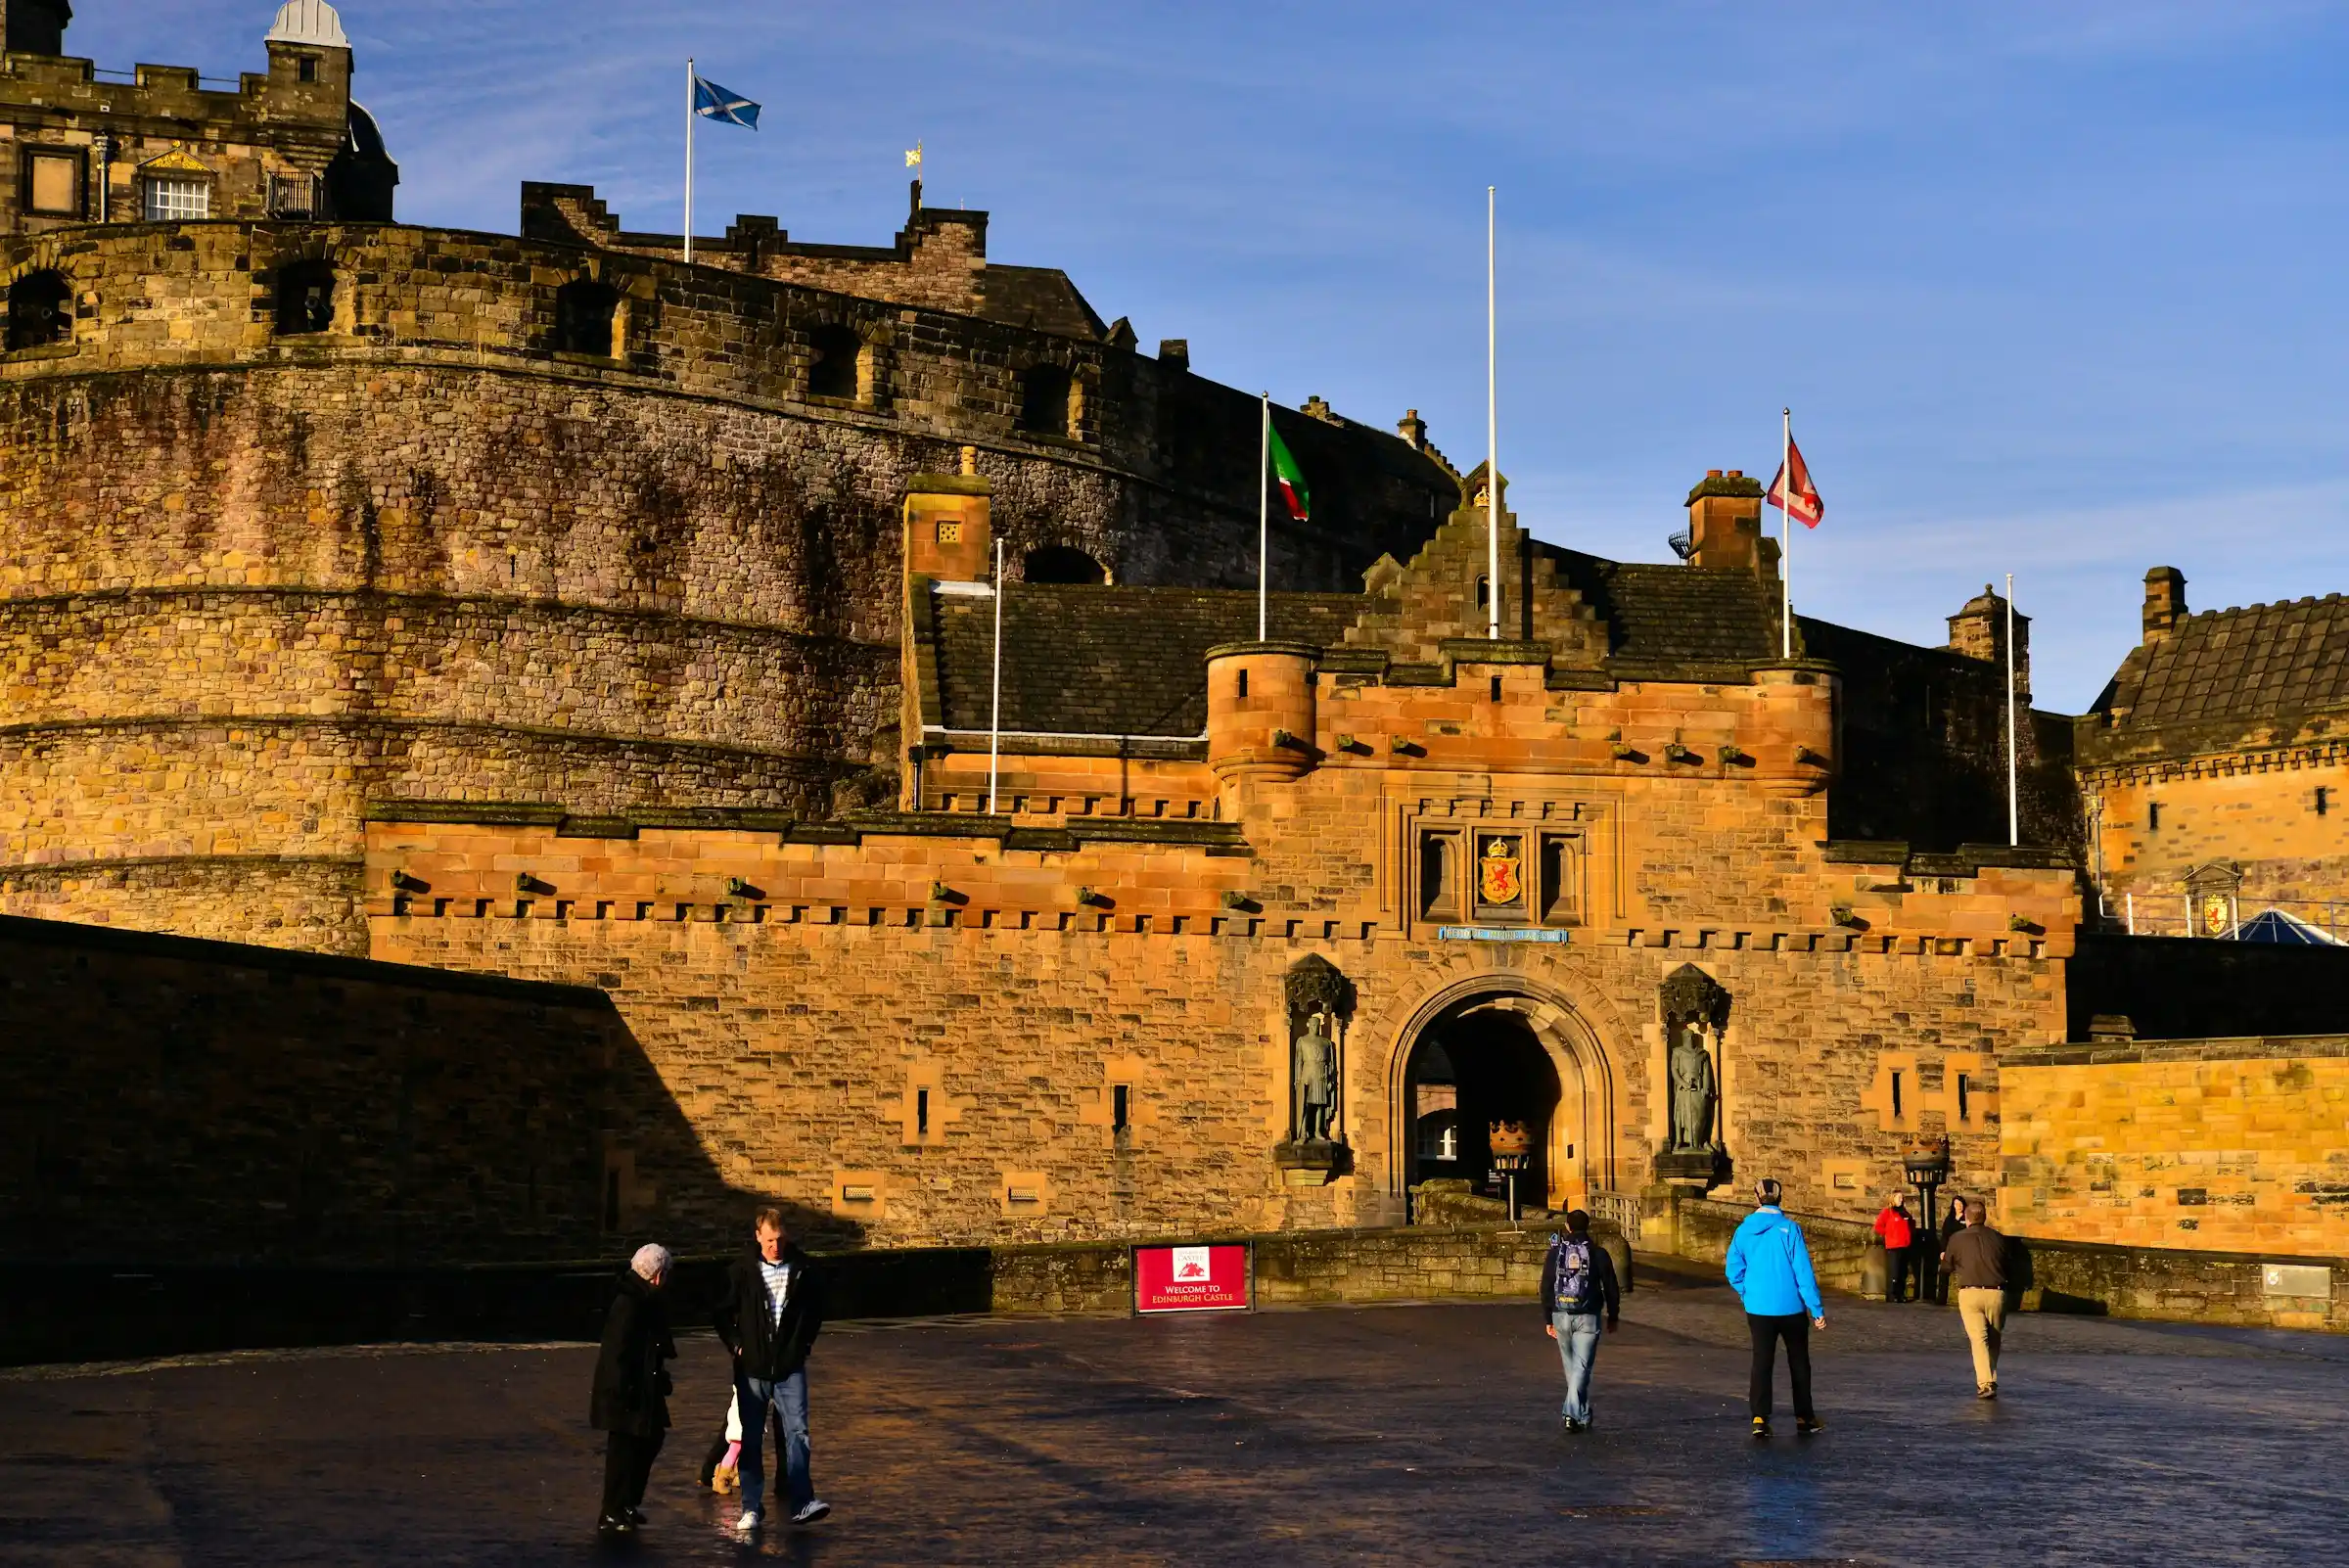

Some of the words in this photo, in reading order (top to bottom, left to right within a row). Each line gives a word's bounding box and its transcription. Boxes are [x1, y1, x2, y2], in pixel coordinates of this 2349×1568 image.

[1165, 1285, 1207, 1294] WELCOME
[1209, 1284, 1221, 1293] TO
[1152, 1294, 1202, 1304] EDINBURGH
[1203, 1293, 1233, 1302] CASTLE
